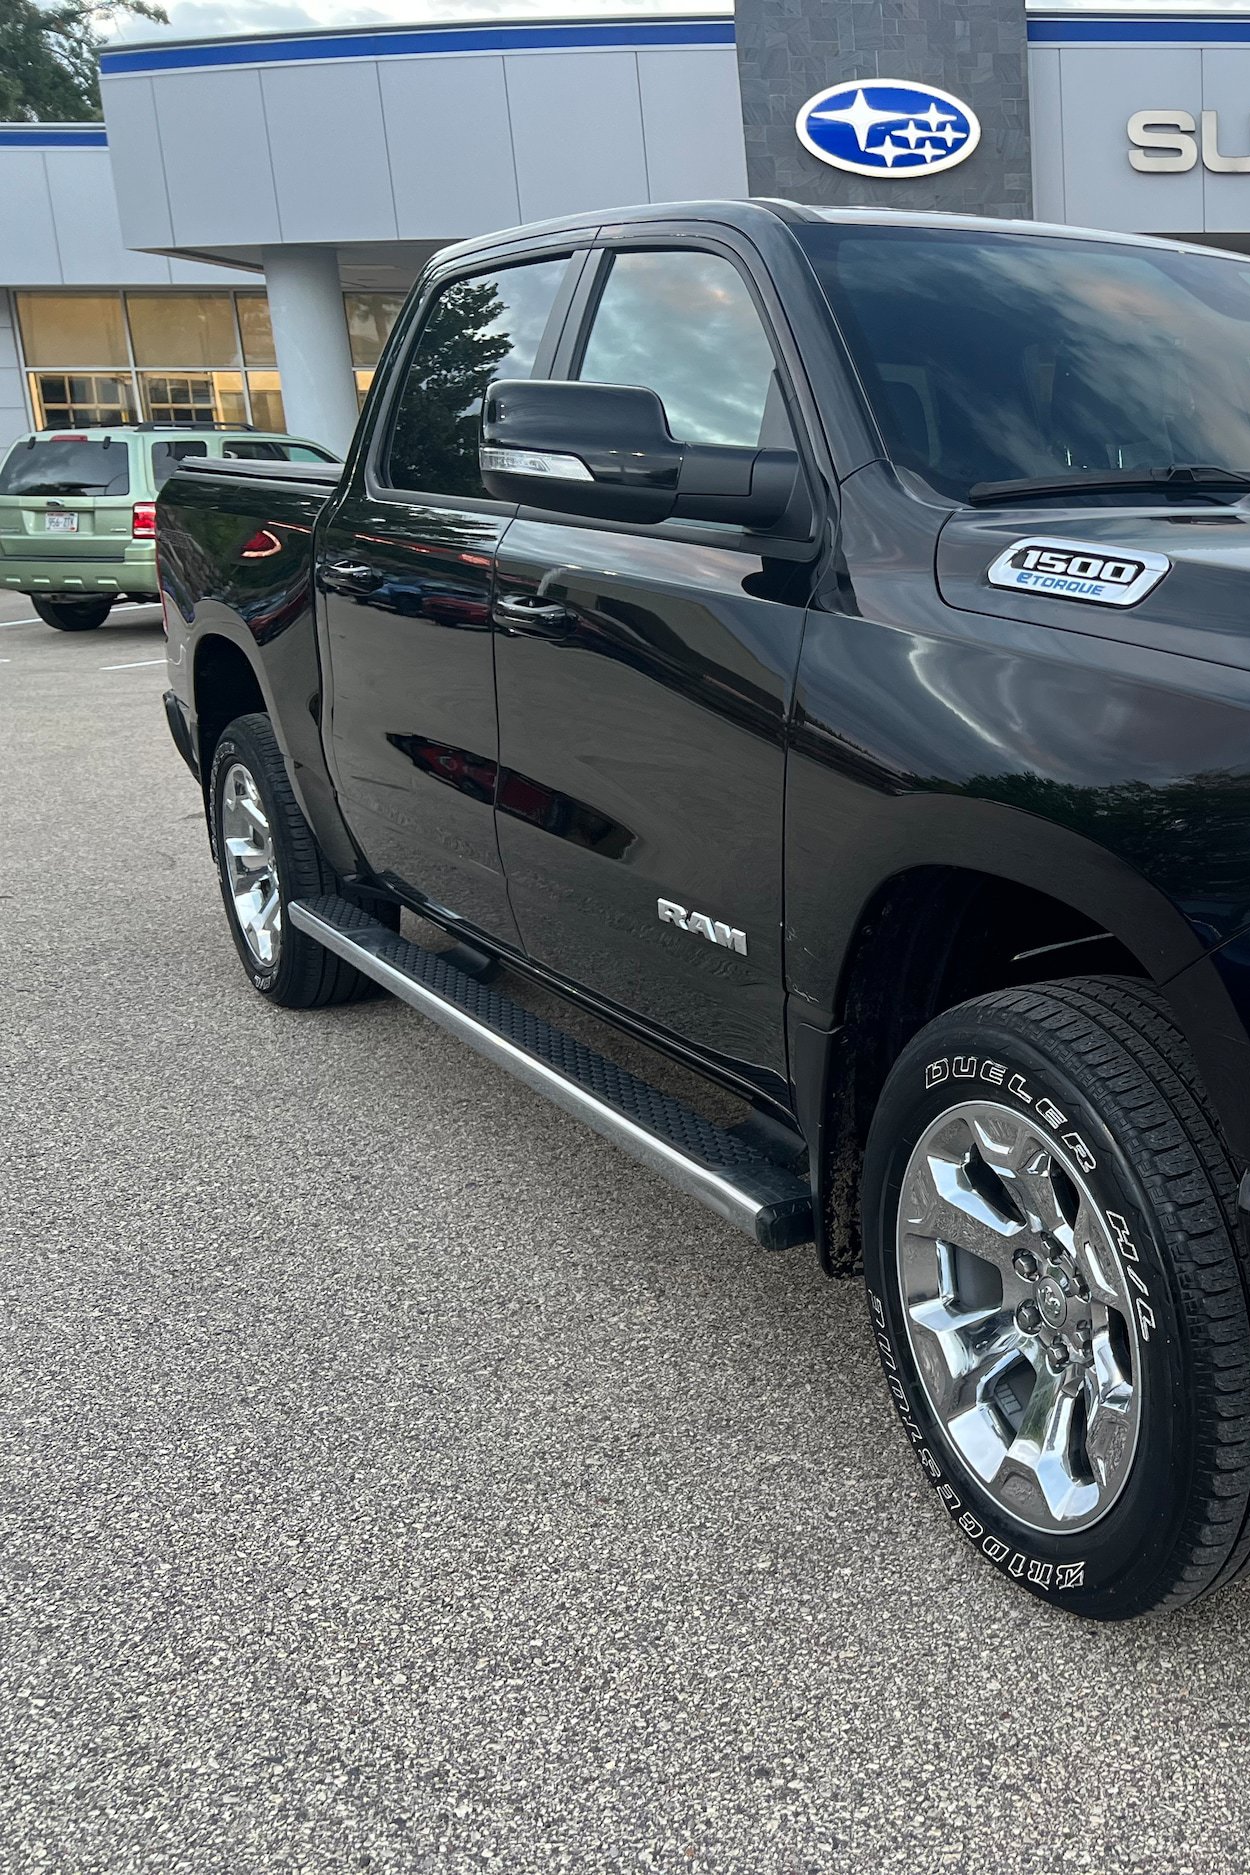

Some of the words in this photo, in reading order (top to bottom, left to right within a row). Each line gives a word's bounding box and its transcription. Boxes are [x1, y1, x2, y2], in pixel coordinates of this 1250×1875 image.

[1022, 549, 1139, 583] 1500
[657, 897, 748, 957] RAM
[925, 1055, 1098, 1174] DUELER
